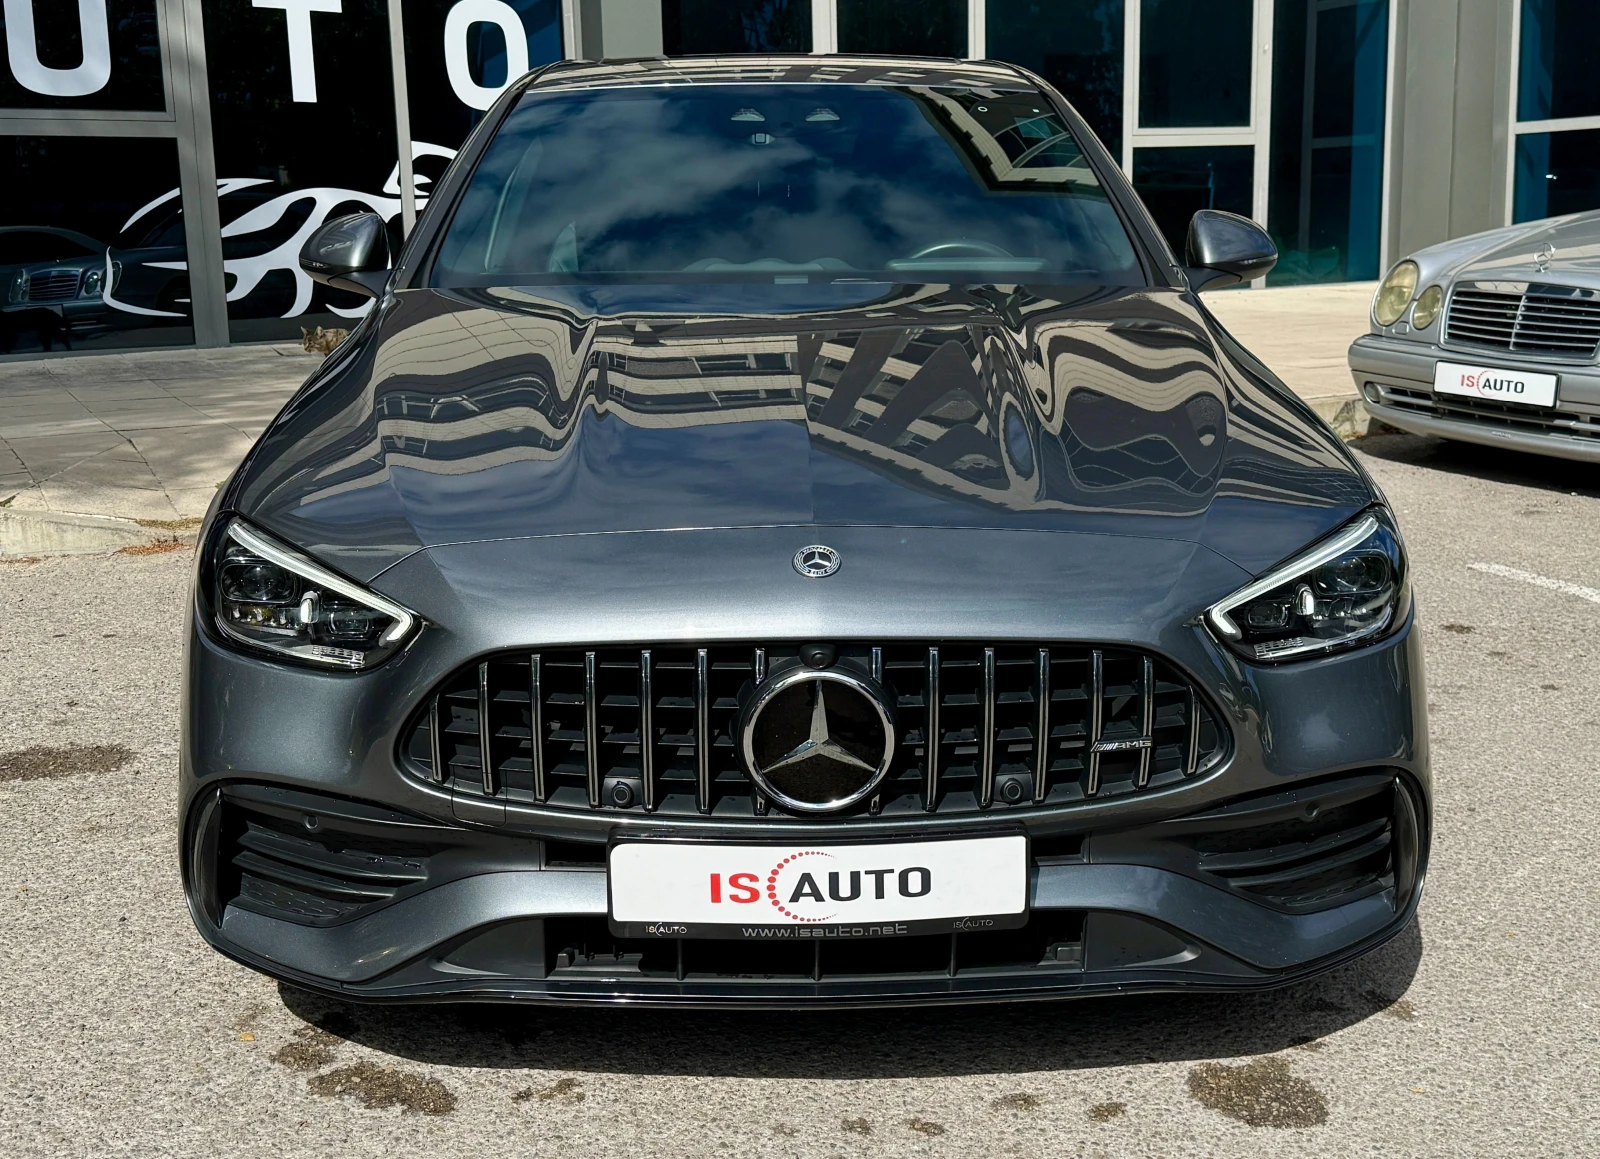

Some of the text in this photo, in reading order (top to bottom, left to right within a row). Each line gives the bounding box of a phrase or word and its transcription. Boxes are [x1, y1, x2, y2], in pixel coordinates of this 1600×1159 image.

[1460, 374, 1525, 394] IS AUTO
[710, 866, 932, 904] IS AUTO
[742, 923, 908, 937] www.isauto.net
